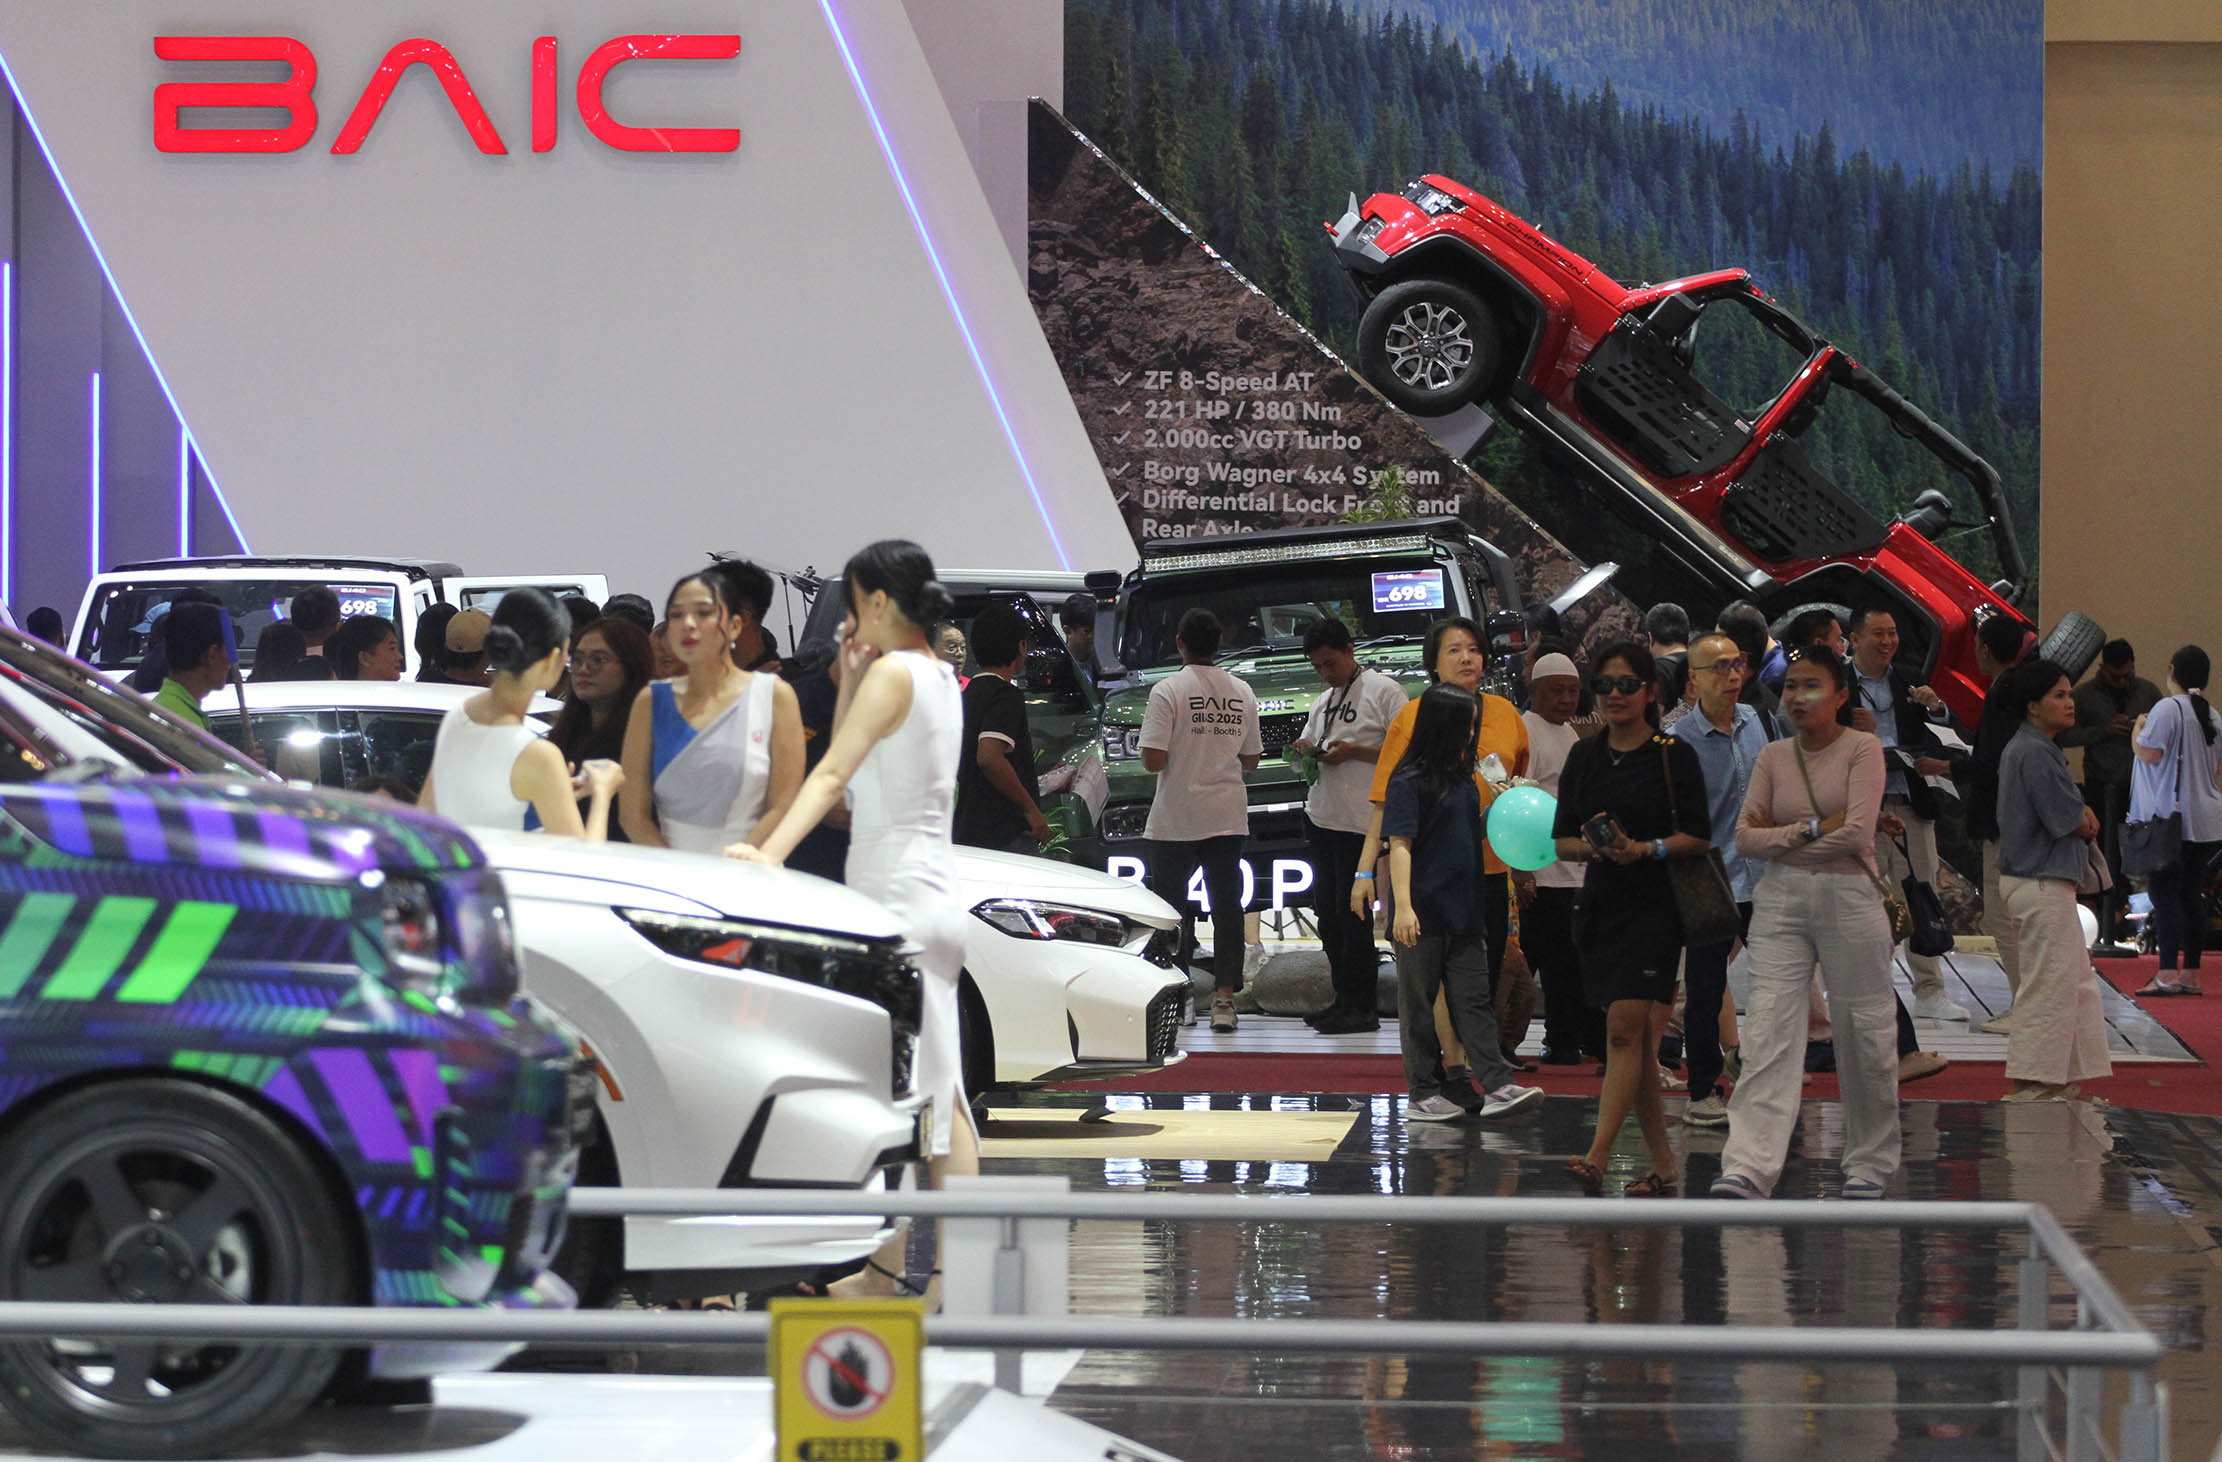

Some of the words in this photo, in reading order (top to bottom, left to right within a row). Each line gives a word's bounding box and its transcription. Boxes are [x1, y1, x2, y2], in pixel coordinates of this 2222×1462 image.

[154, 35, 740, 154] BAIC
[1506, 222, 1583, 275] CHAMPION
[1144, 371, 1173, 390] ZF
[1180, 371, 1277, 396] 8-Speed
[1284, 372, 1314, 391] AT
[1144, 400, 1186, 419] 221
[1196, 401, 1230, 419] HP
[1235, 401, 1246, 420] /
[1252, 401, 1296, 420] 380
[1303, 402, 1341, 420] Nm
[1144, 428, 1235, 449] 2.000cc
[1239, 430, 1288, 449] VGT
[1293, 430, 1362, 450] Turbo
[1144, 461, 1200, 486] Borg
[1206, 462, 1297, 488] Wagner
[1303, 464, 1346, 484] 4x4
[1143, 490, 1274, 512] Differential
[1282, 493, 1336, 513] Lock
[1416, 495, 1460, 514] and
[1142, 519, 1196, 538] Rear
[1389, 585, 1427, 602] 698
[340, 600, 378, 615] 698
[1189, 696, 1243, 712] BAIC
[1217, 713, 1242, 725] 2025
[1213, 726, 1237, 736] Booth
